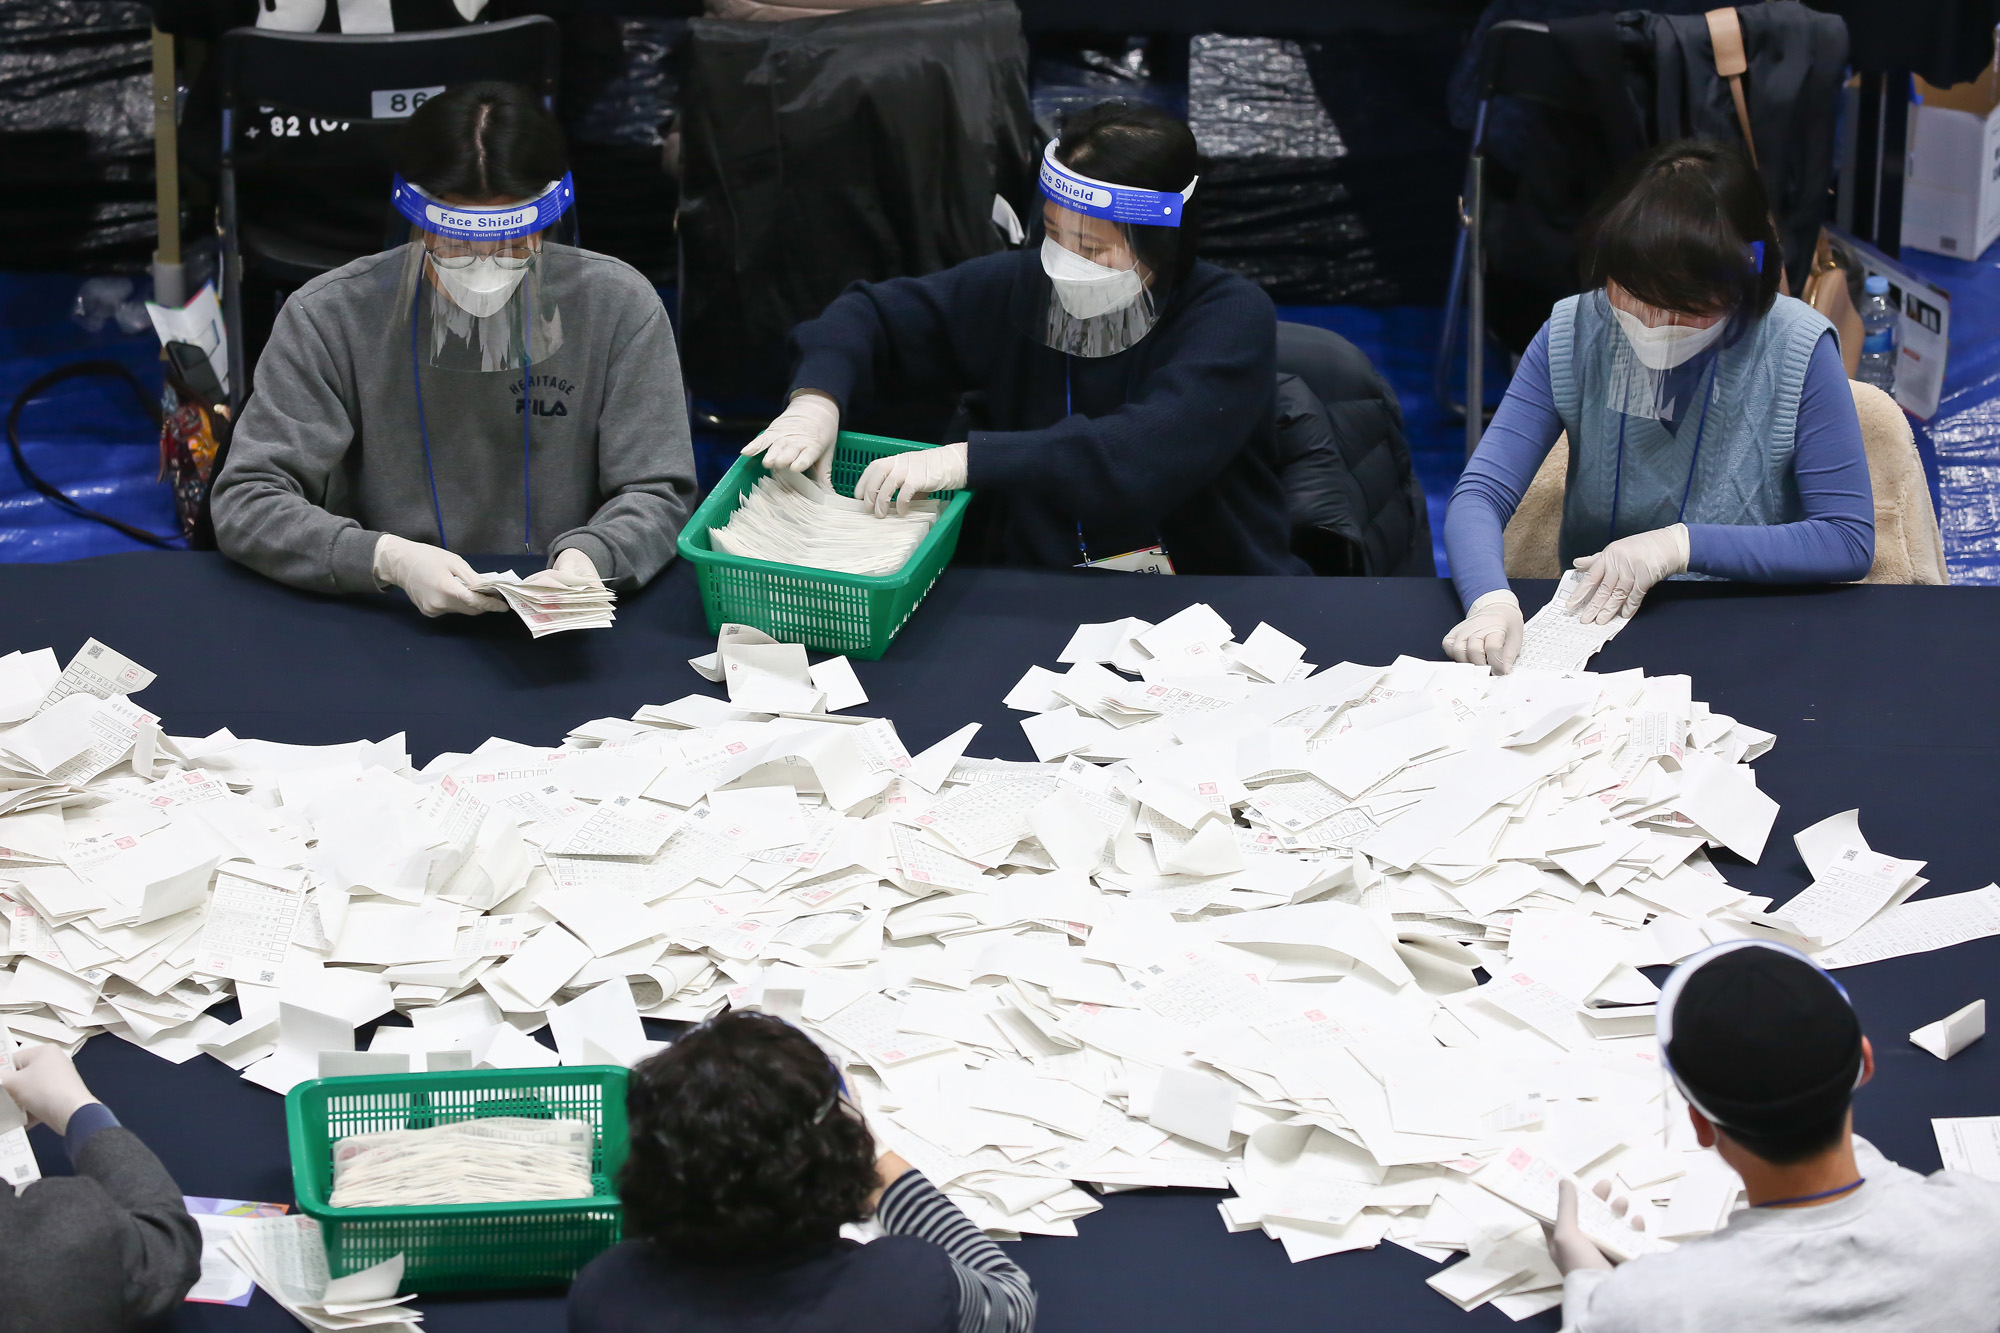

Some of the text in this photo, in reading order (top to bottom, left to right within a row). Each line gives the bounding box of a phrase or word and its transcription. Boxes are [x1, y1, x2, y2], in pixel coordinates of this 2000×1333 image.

[270, 115, 300, 137] 82
[1054, 178, 1094, 202] Shield
[1072, 201, 1088, 211] Mask
[441, 212, 524, 228] Face Shield
[439, 227, 470, 237] Protective
[504, 229, 521, 237] Mask
[509, 375, 575, 396] HERITAGE
[516, 399, 568, 417] FILA
